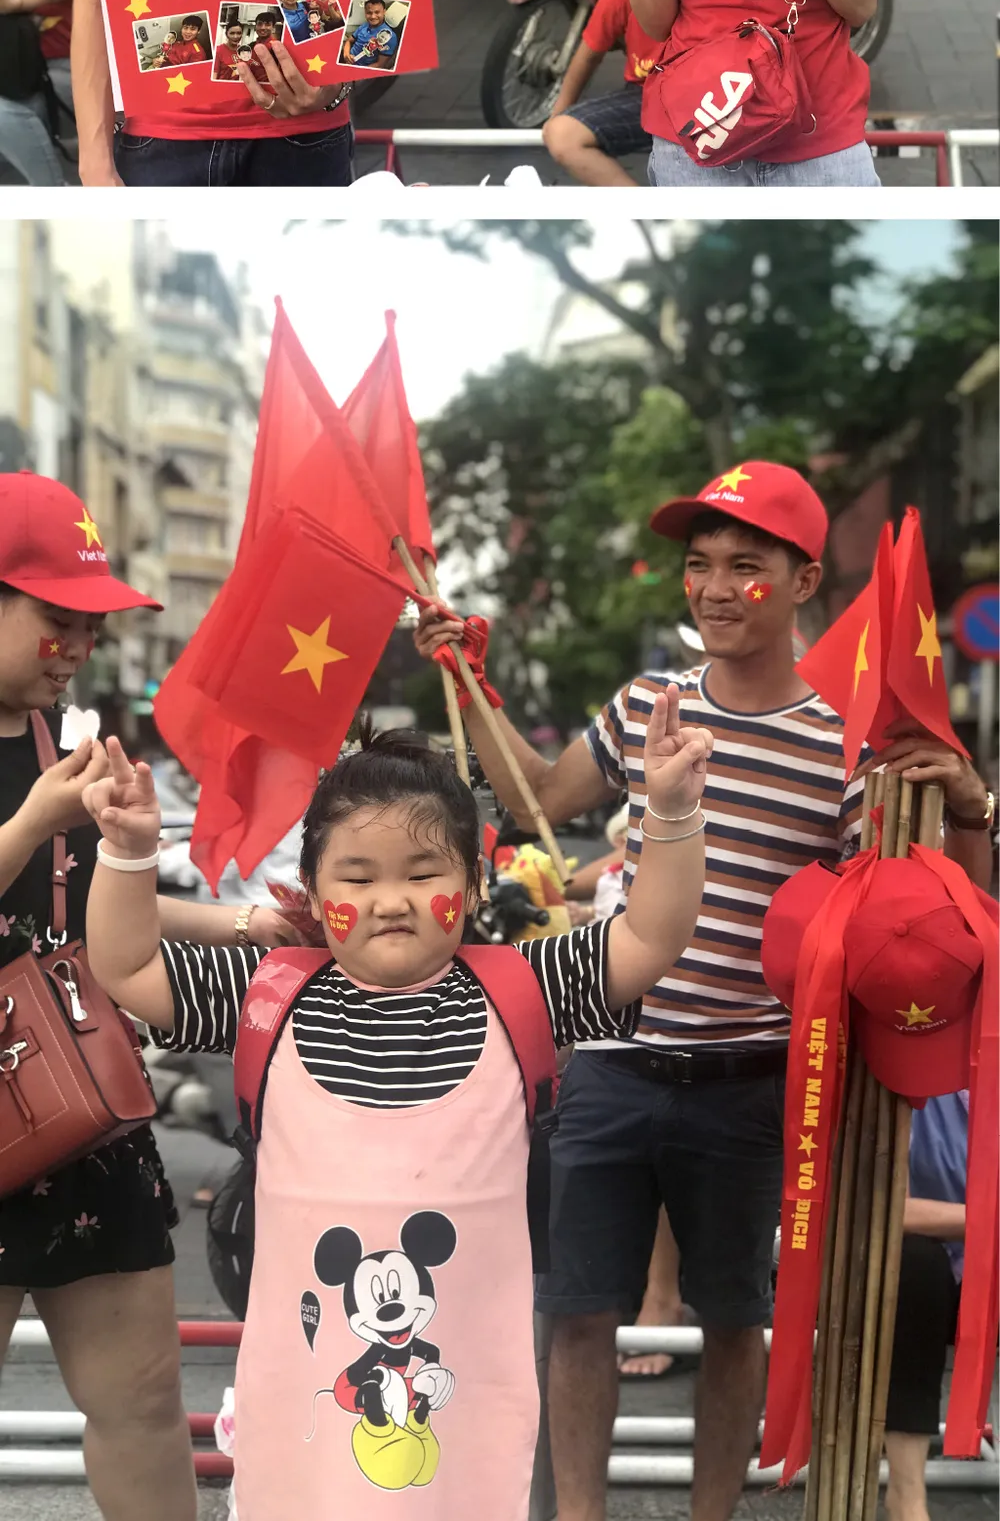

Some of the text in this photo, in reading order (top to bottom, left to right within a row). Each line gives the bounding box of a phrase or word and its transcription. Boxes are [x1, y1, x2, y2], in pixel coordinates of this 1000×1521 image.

[721, 491, 745, 503] Nam
[76, 549, 97, 562] Viet
[806, 1017, 828, 1071] VIỆT
[803, 1077, 822, 1127] NAM
[797, 1161, 817, 1191] VÔ
[302, 1312, 319, 1326] GIRL
